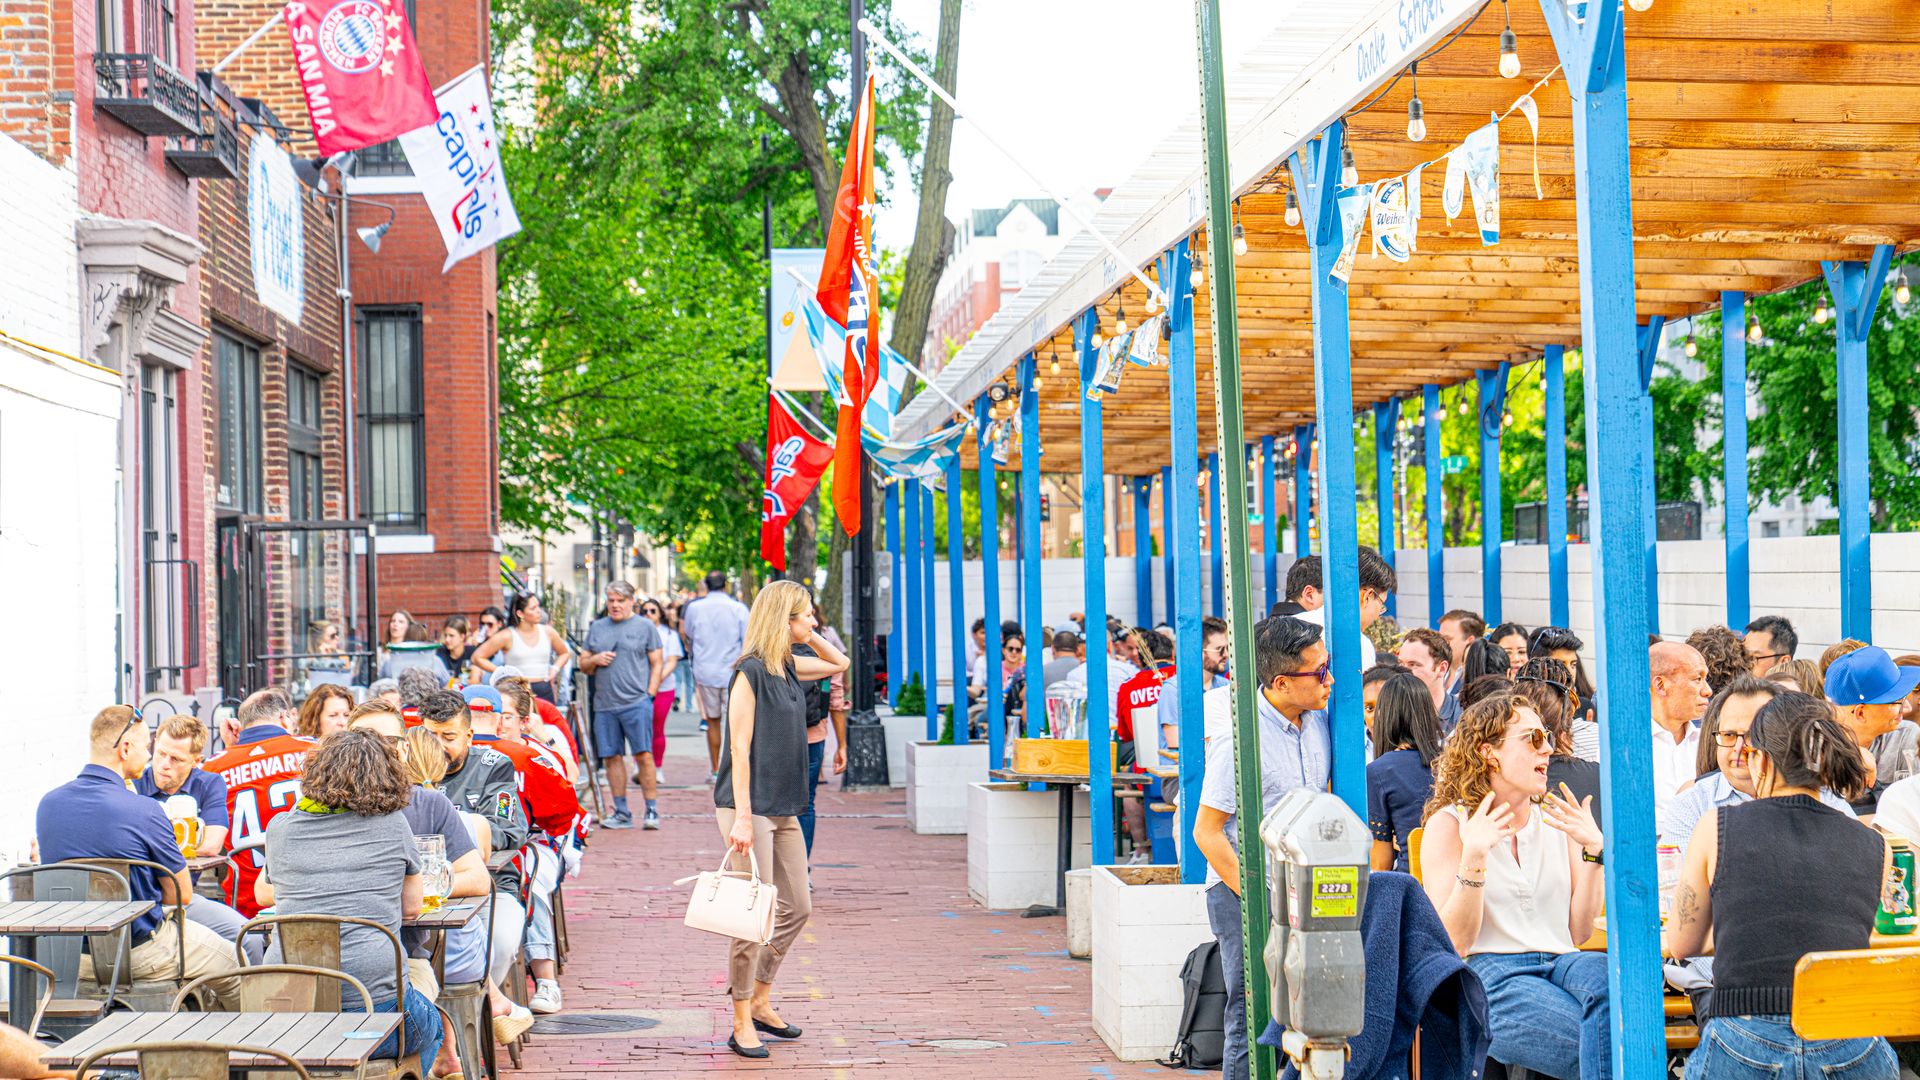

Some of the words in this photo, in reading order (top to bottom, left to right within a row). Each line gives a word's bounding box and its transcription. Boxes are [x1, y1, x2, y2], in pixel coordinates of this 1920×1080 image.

[354, 2, 371, 15] FC
[292, 24, 323, 82] SAN
[306, 83, 337, 138] MIA
[1321, 883, 1348, 894] 2278
